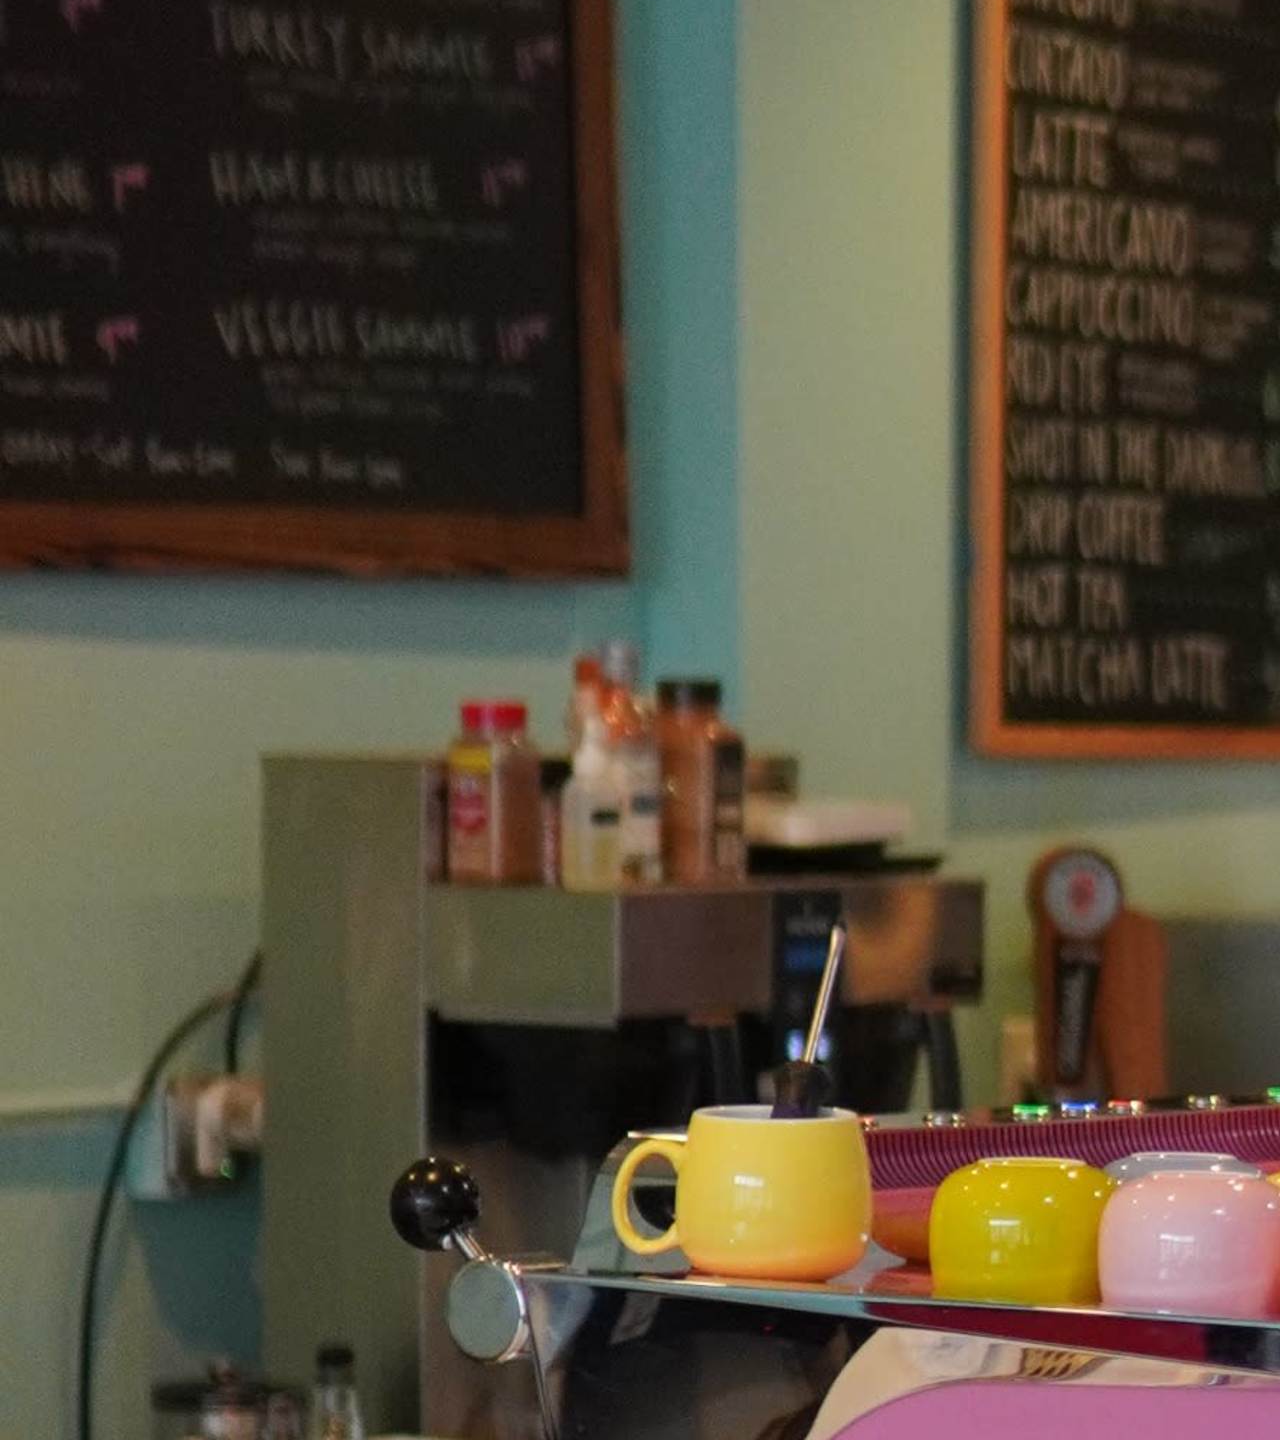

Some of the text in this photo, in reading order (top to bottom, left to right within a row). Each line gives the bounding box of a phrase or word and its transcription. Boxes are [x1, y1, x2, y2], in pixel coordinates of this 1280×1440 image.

[208, 3, 349, 82] TURKEY
[208, 152, 300, 210] HAM
[1013, 105, 1114, 189] LATTE
[1012, 188, 1195, 278] AMERICANO
[211, 299, 347, 360] VEGGIE
[1006, 263, 1197, 348] CAPPUCCINO
[1006, 418, 1075, 484] SHOT
[1075, 493, 1167, 567] COFFEE
[1008, 564, 1129, 632] HOT TEA
[1008, 634, 1147, 709] MATCHA
[1150, 634, 1231, 712] LATTE
